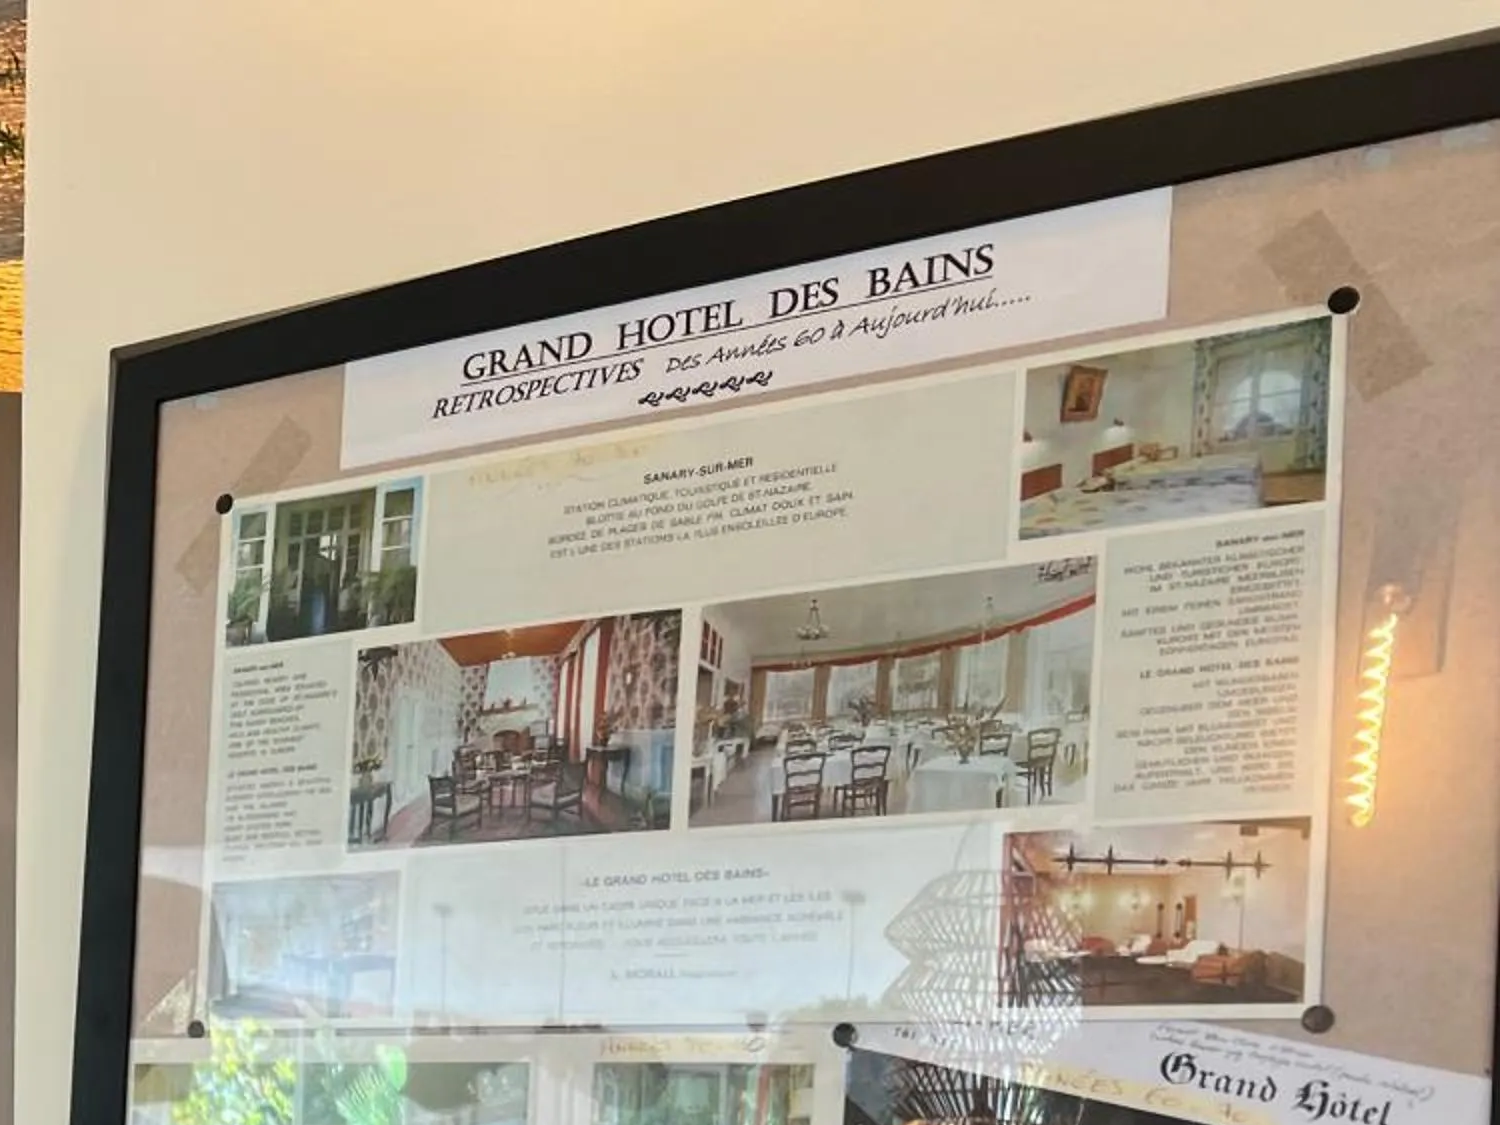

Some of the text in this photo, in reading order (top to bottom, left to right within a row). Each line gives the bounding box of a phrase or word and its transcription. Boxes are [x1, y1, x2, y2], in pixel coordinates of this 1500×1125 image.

[462, 243, 995, 381] GRAND HOTEL DES BAINS
[432, 358, 645, 419] RETROSPECTIVES
[794, 325, 825, 347] 60
[829, 318, 846, 342] à
[1159, 1051, 1277, 1103] Grand
